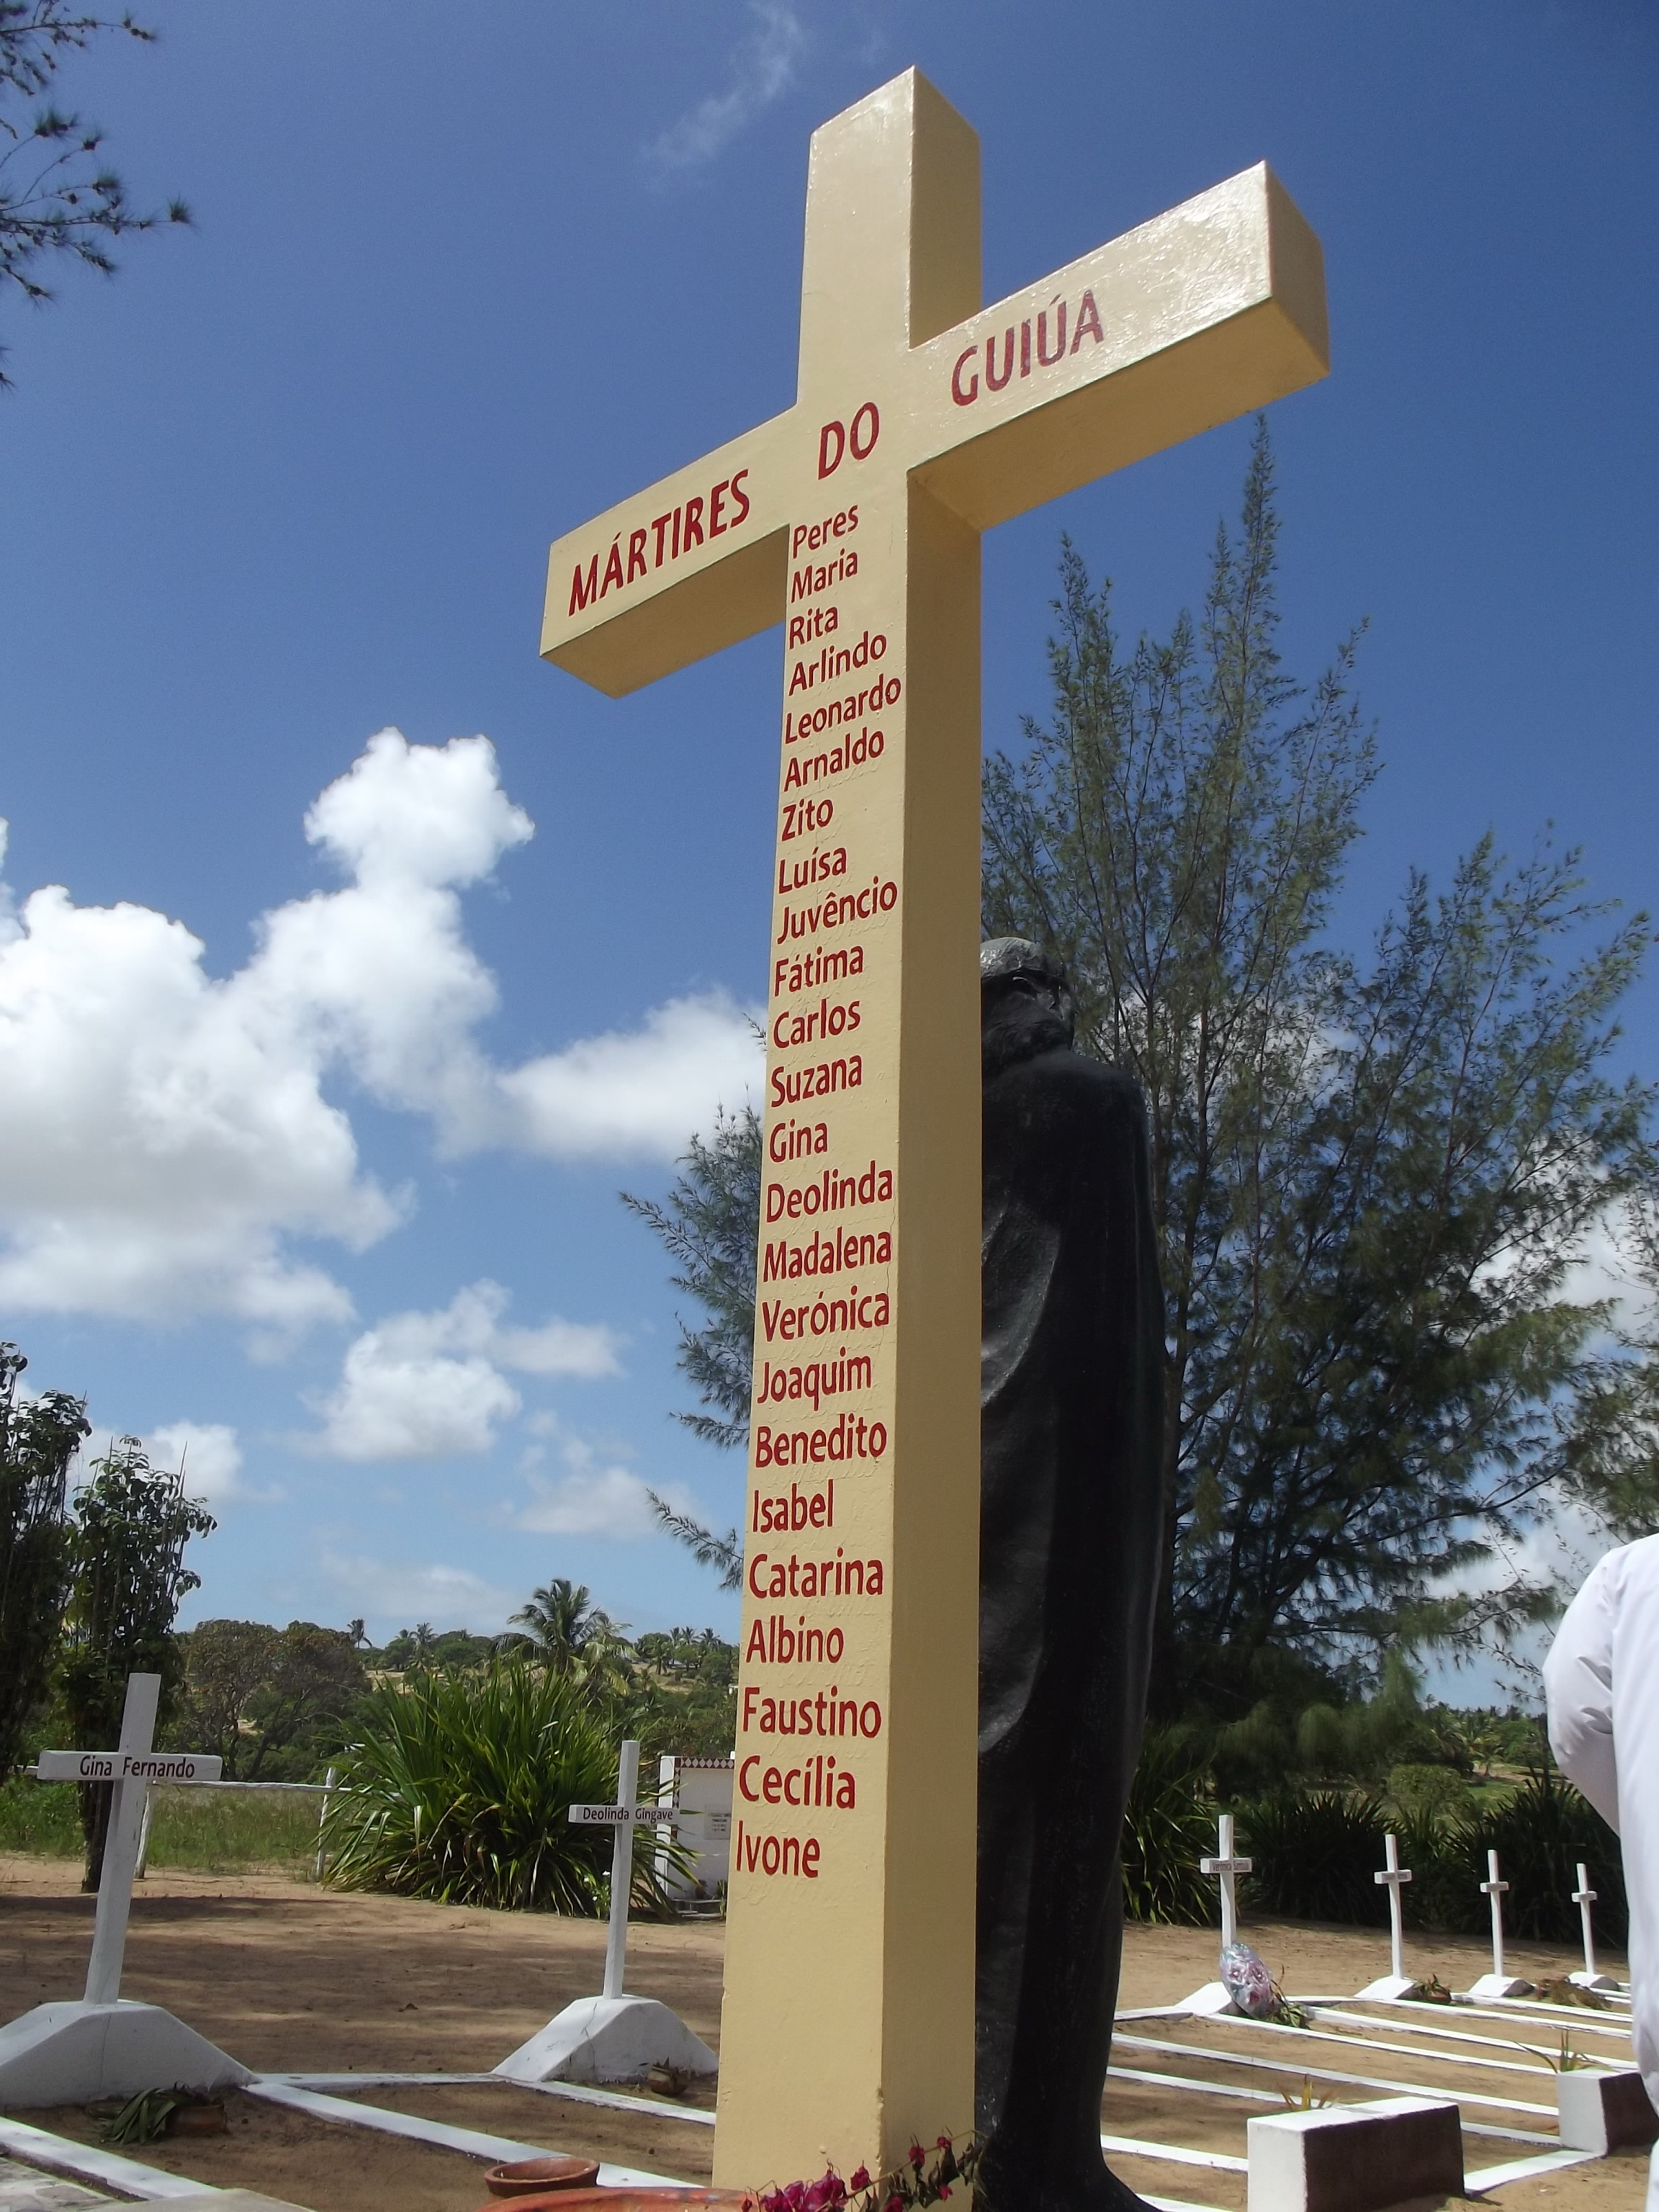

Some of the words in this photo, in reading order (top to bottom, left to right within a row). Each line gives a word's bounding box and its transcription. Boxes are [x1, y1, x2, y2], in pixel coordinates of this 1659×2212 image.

[570, 470, 749, 615] MÁRTIRES
[818, 403, 878, 479] DO
[952, 291, 1103, 406] GUIÚA
[793, 507, 858, 557] Peres
[792, 553, 857, 600] Maria
[789, 608, 837, 648] Rita
[789, 633, 886, 694] Arlindo
[786, 674, 900, 743] Leonardo
[784, 728, 884, 790] Arnaldo
[782, 801, 832, 841] Zito
[779, 848, 846, 893] Luísa
[778, 877, 897, 943] Juvêncio
[775, 947, 863, 995] Fátima
[773, 999, 860, 1048] Carlos
[772, 1056, 862, 1107] Suzana
[770, 1120, 827, 1162] Gina
[766, 1161, 892, 1223] Deolinda
[763, 1227, 891, 1280] Madalena
[762, 1286, 889, 1341] Verónica
[757, 1348, 871, 1411] Joaquim
[755, 1414, 887, 1467] Benedito
[753, 1480, 832, 1532] Isabel
[749, 1548, 883, 1598] Catarina
[747, 1617, 844, 1663] Albino
[743, 1686, 881, 1737] Faustino
[80, 1755, 113, 1776] Gina
[122, 1756, 195, 1778] Fernando
[739, 1755, 855, 1809] Cecília
[583, 1807, 629, 1821] Deolinda
[635, 1807, 673, 1824] Gingave
[737, 1820, 819, 1878] Ivone
